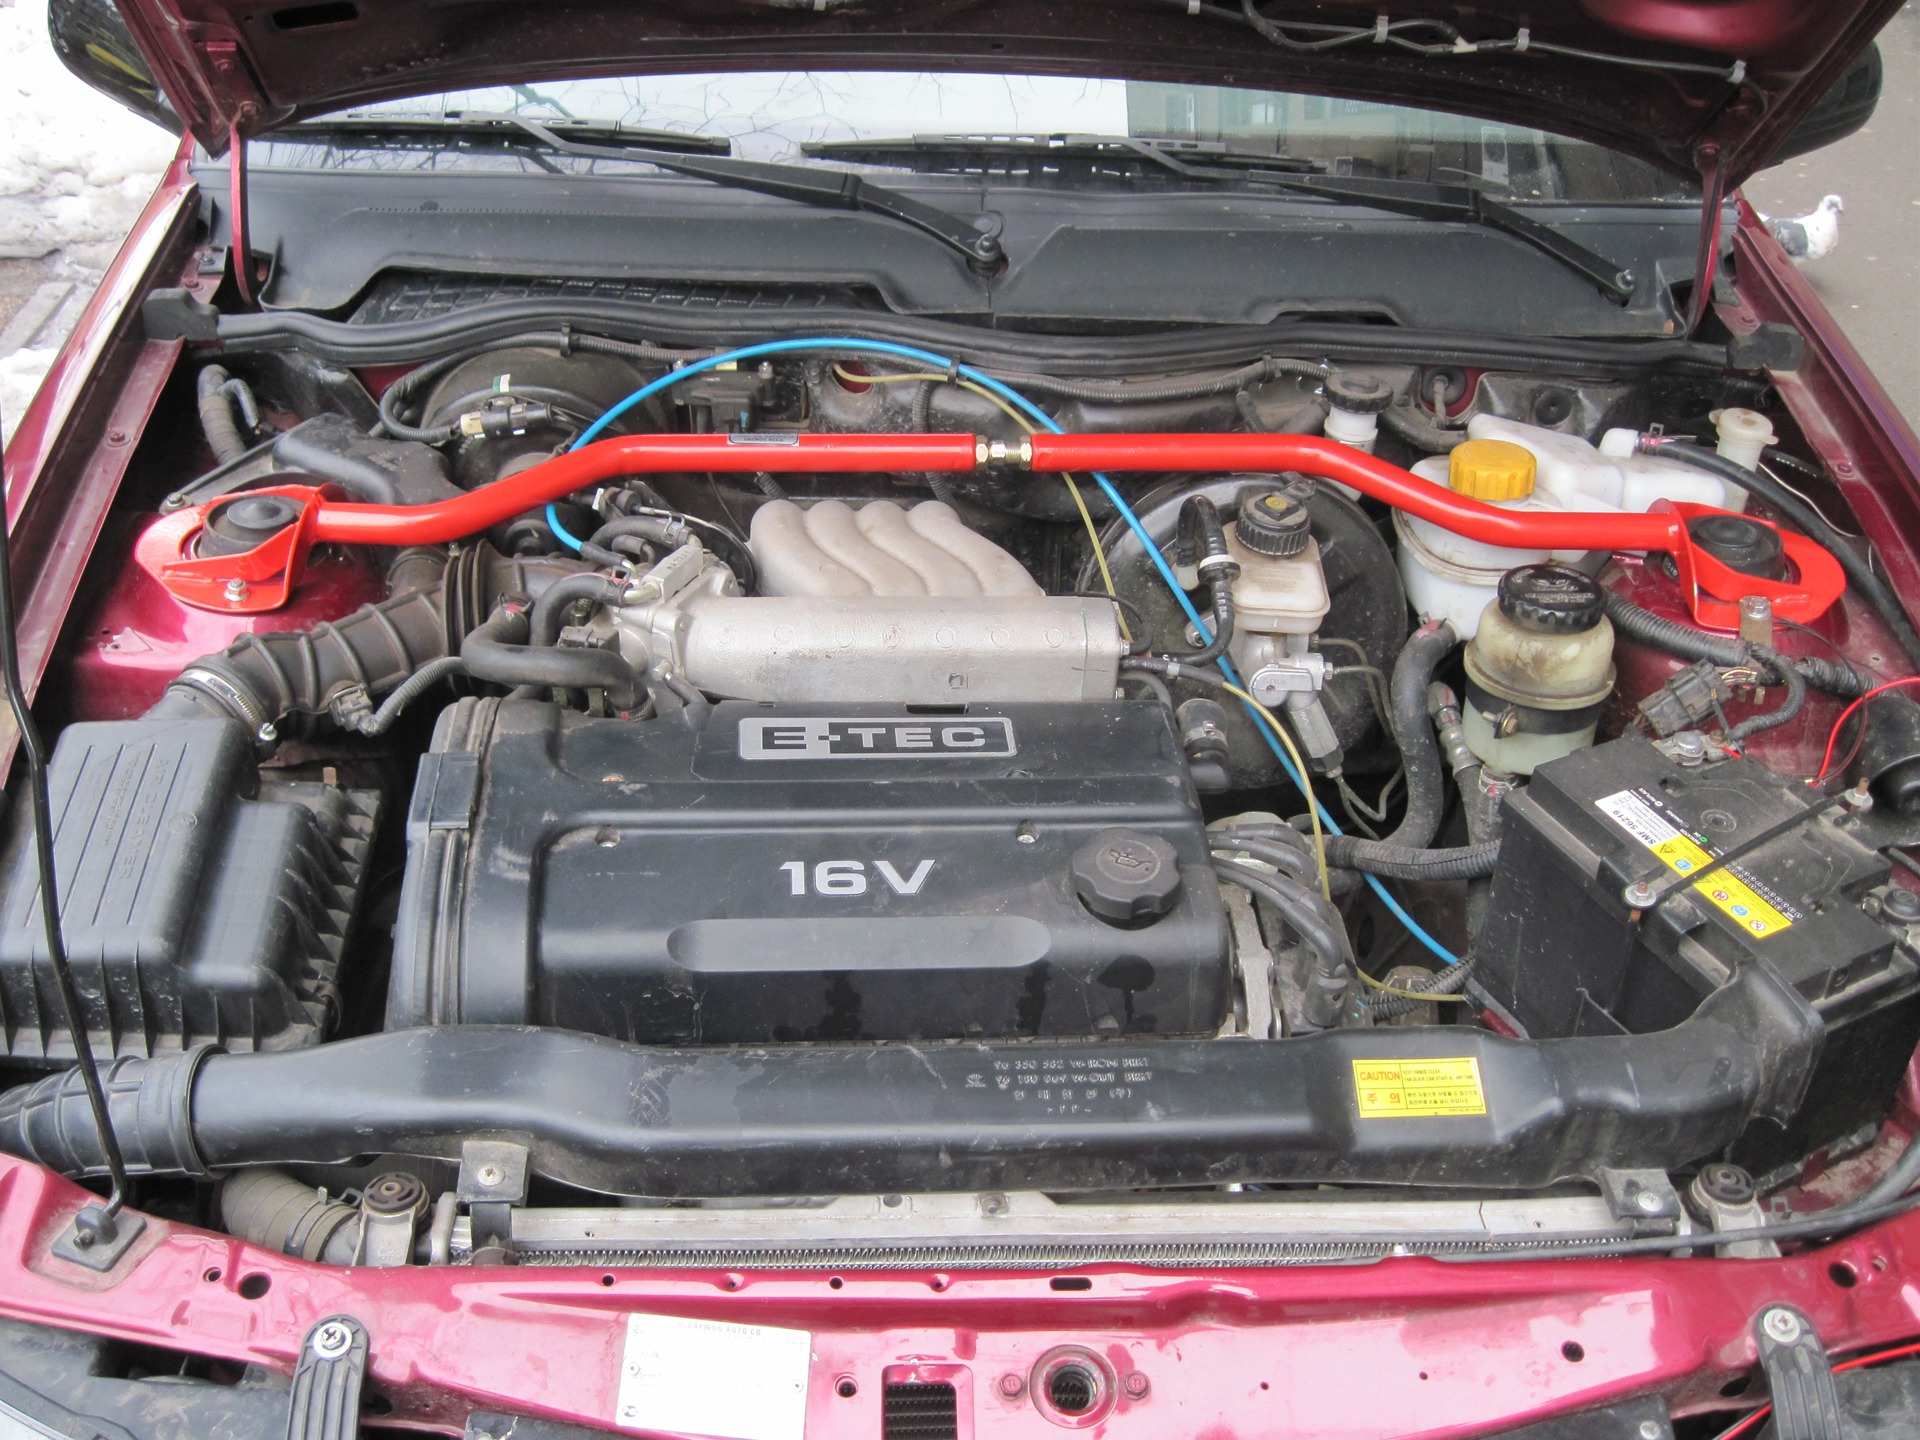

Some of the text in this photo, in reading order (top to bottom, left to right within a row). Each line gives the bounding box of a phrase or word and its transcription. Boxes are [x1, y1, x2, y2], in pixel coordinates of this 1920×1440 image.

[762, 726, 986, 750] E-TEC
[1612, 809, 1640, 831] 56219
[1665, 809, 1684, 823] CHARGE
[1636, 828, 1657, 845] SMF
[779, 859, 936, 896] 16V
[1360, 1071, 1401, 1081] CAUTION
[726, 1326, 748, 1336] AUTO
